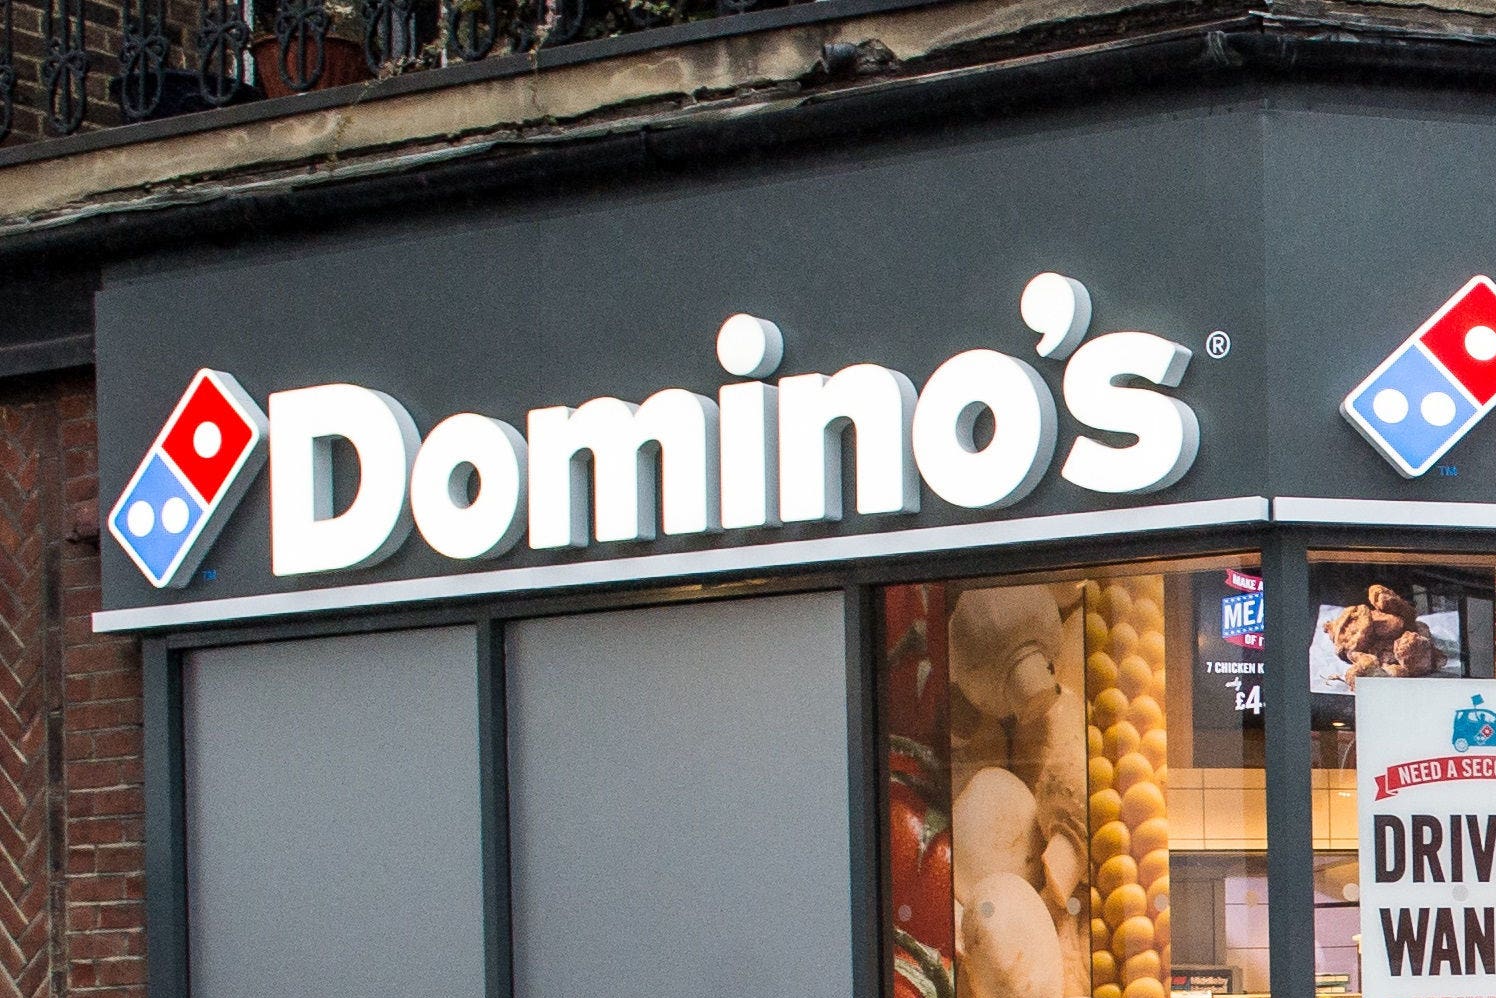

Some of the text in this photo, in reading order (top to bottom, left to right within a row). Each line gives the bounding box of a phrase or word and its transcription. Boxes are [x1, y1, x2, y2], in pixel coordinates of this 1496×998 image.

[268, 272, 1201, 578] Domino's
[1232, 573, 1256, 590] MAKE
[1244, 634, 1257, 646] OF
[1206, 661, 1213, 673] 7
[1214, 661, 1256, 674] CHICKEN
[1398, 761, 1442, 785] NEED
[1447, 760, 1457, 778] A
